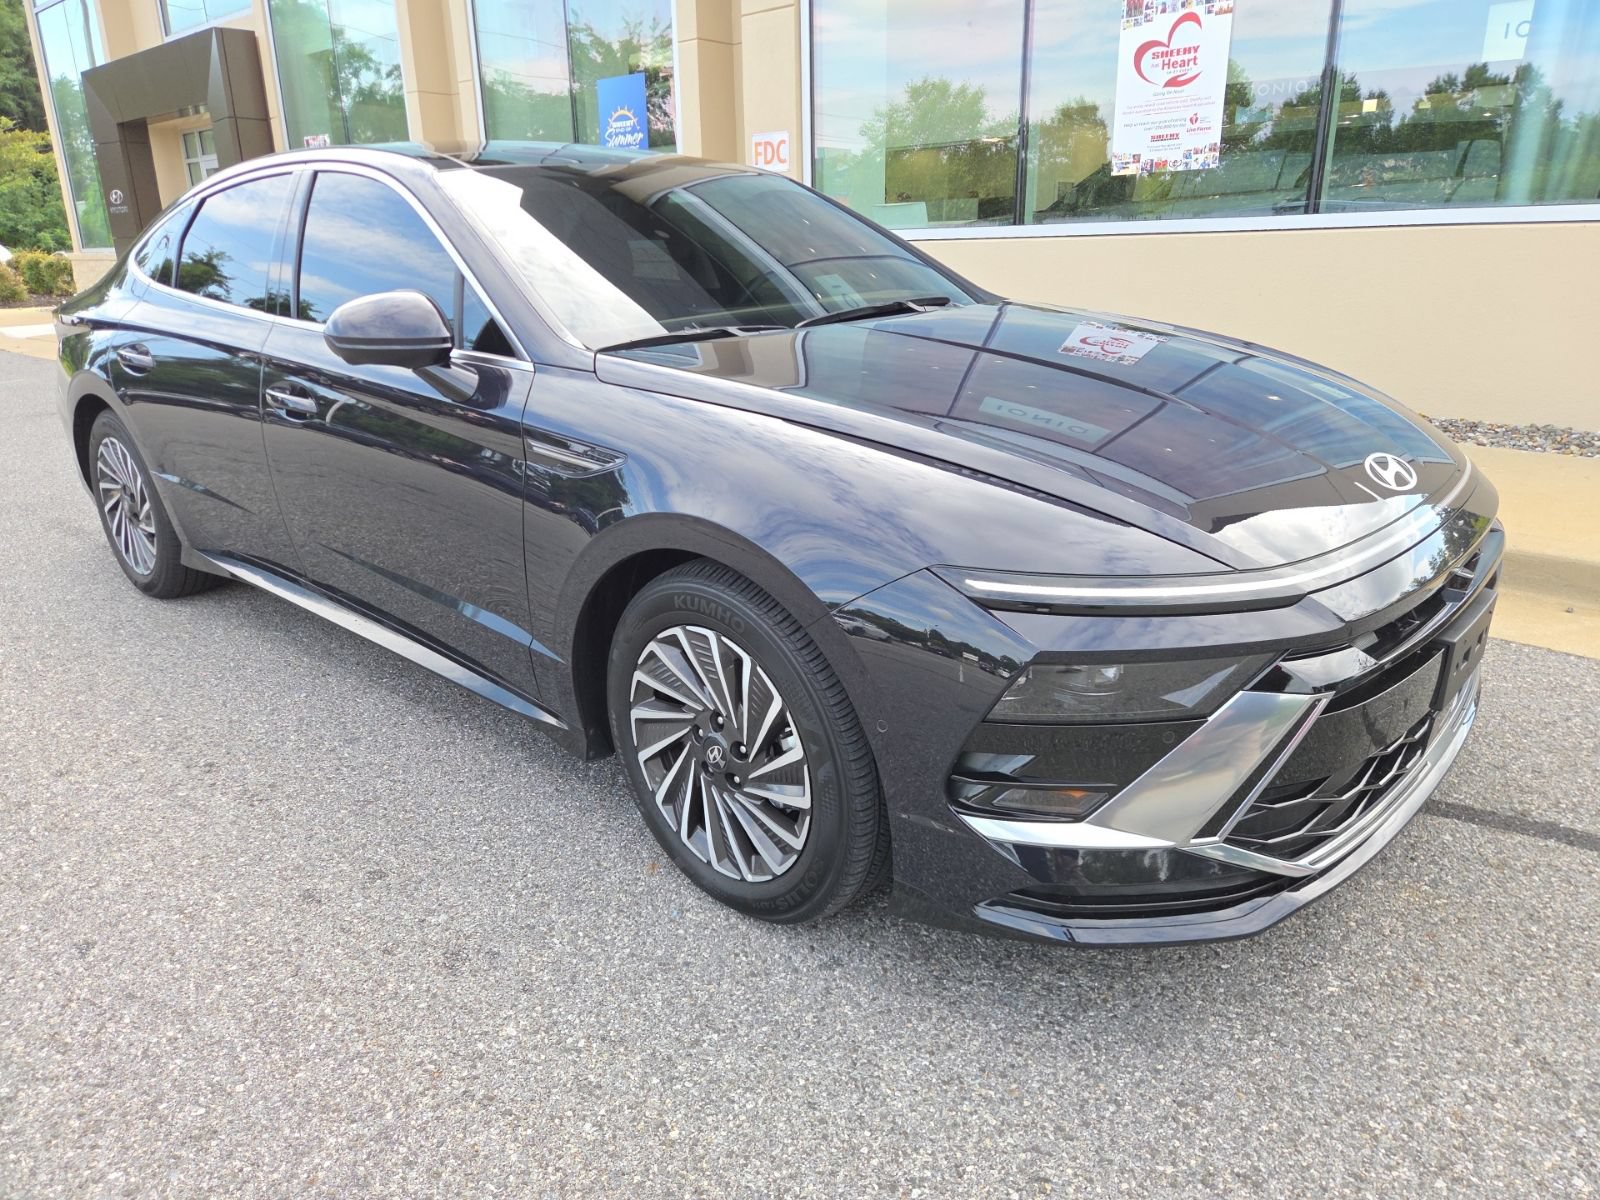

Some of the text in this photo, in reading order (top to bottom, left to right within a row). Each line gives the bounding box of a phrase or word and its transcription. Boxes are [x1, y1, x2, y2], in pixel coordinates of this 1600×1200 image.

[1152, 44, 1200, 60] SHEEHY
[1161, 55, 1198, 70] Heart
[754, 139, 787, 166] FDC
[674, 595, 745, 633] KUMHO
